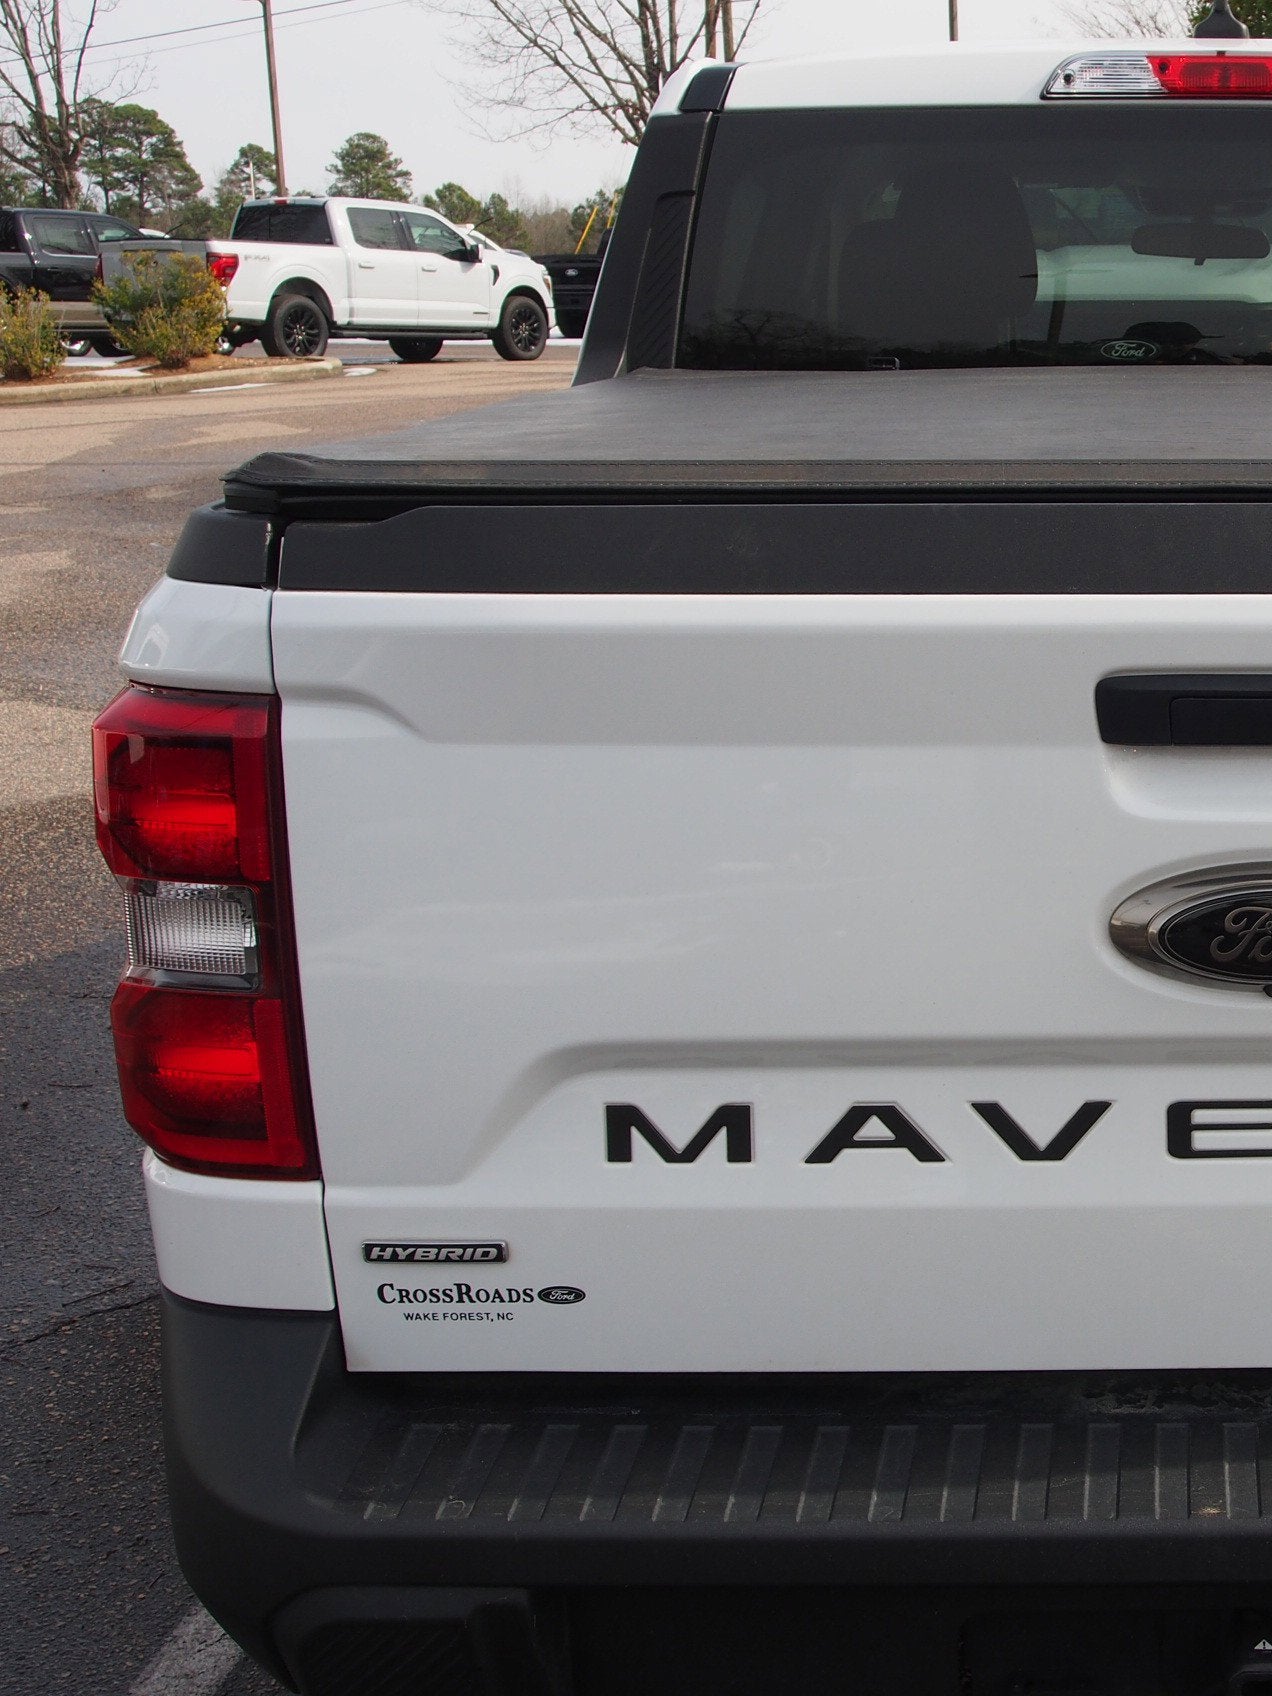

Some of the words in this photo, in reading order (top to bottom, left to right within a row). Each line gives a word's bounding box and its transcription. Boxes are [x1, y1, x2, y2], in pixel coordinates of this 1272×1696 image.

[1112, 342, 1146, 356] Ford
[369, 1247, 498, 1261] HYBRID
[403, 1312, 439, 1322] WAKE
[442, 1312, 494, 1323] FOREST,
[497, 1312, 514, 1322] NC
